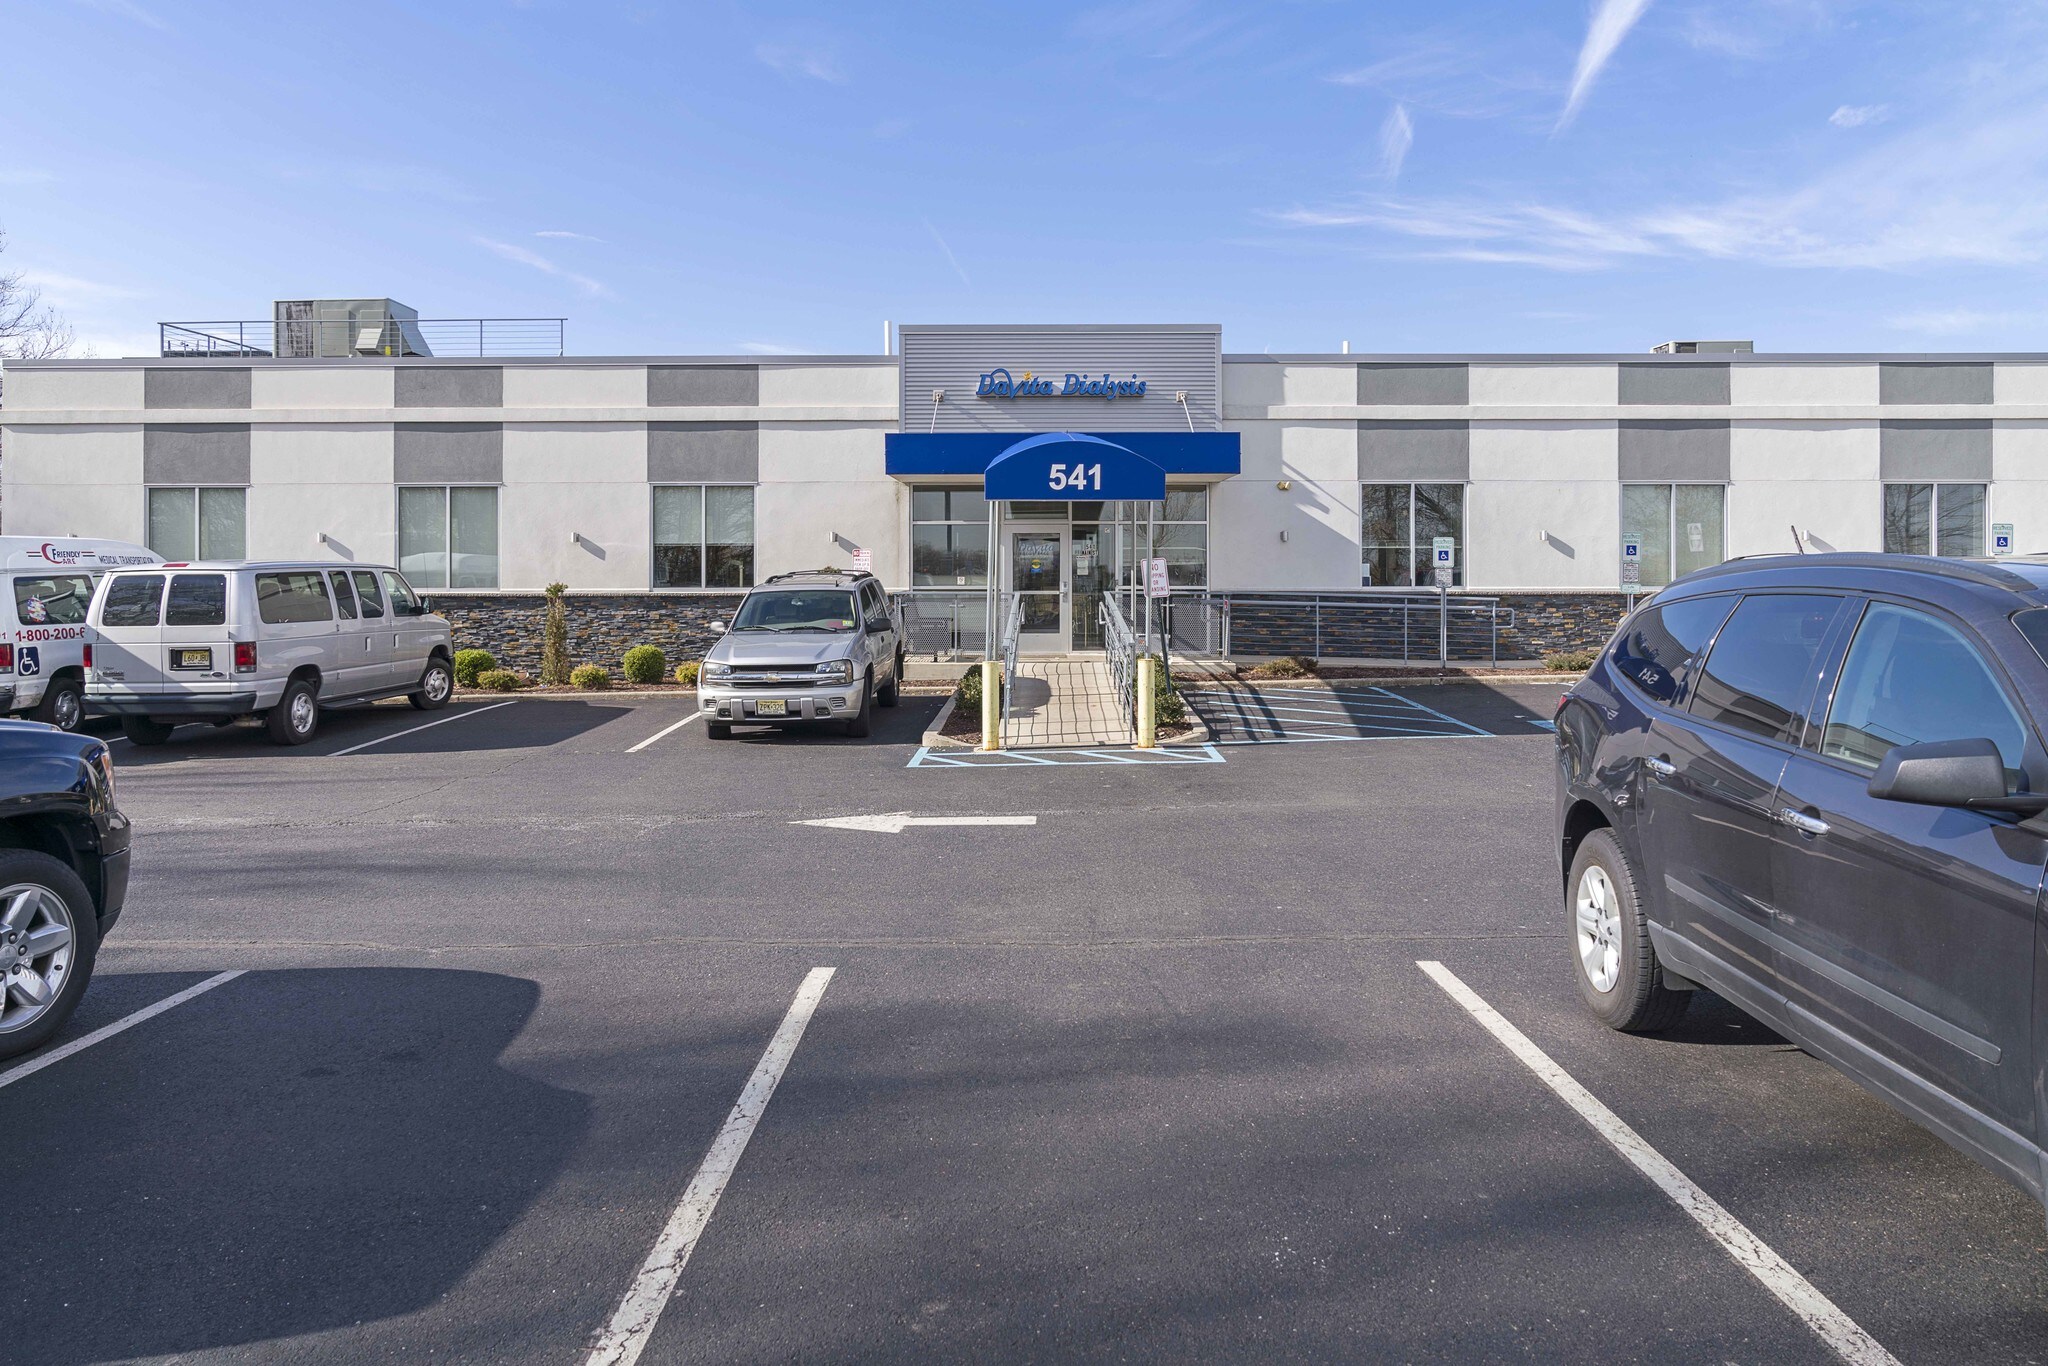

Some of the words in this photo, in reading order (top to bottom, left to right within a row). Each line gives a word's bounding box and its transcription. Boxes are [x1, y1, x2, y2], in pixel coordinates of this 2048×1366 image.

[976, 368, 1053, 399] DaVita
[1061, 374, 1147, 400] Dialysis
[1049, 464, 1101, 490] 541
[52, 549, 80, 560] FRIENDLY
[98, 555, 119, 565] MEDICAL
